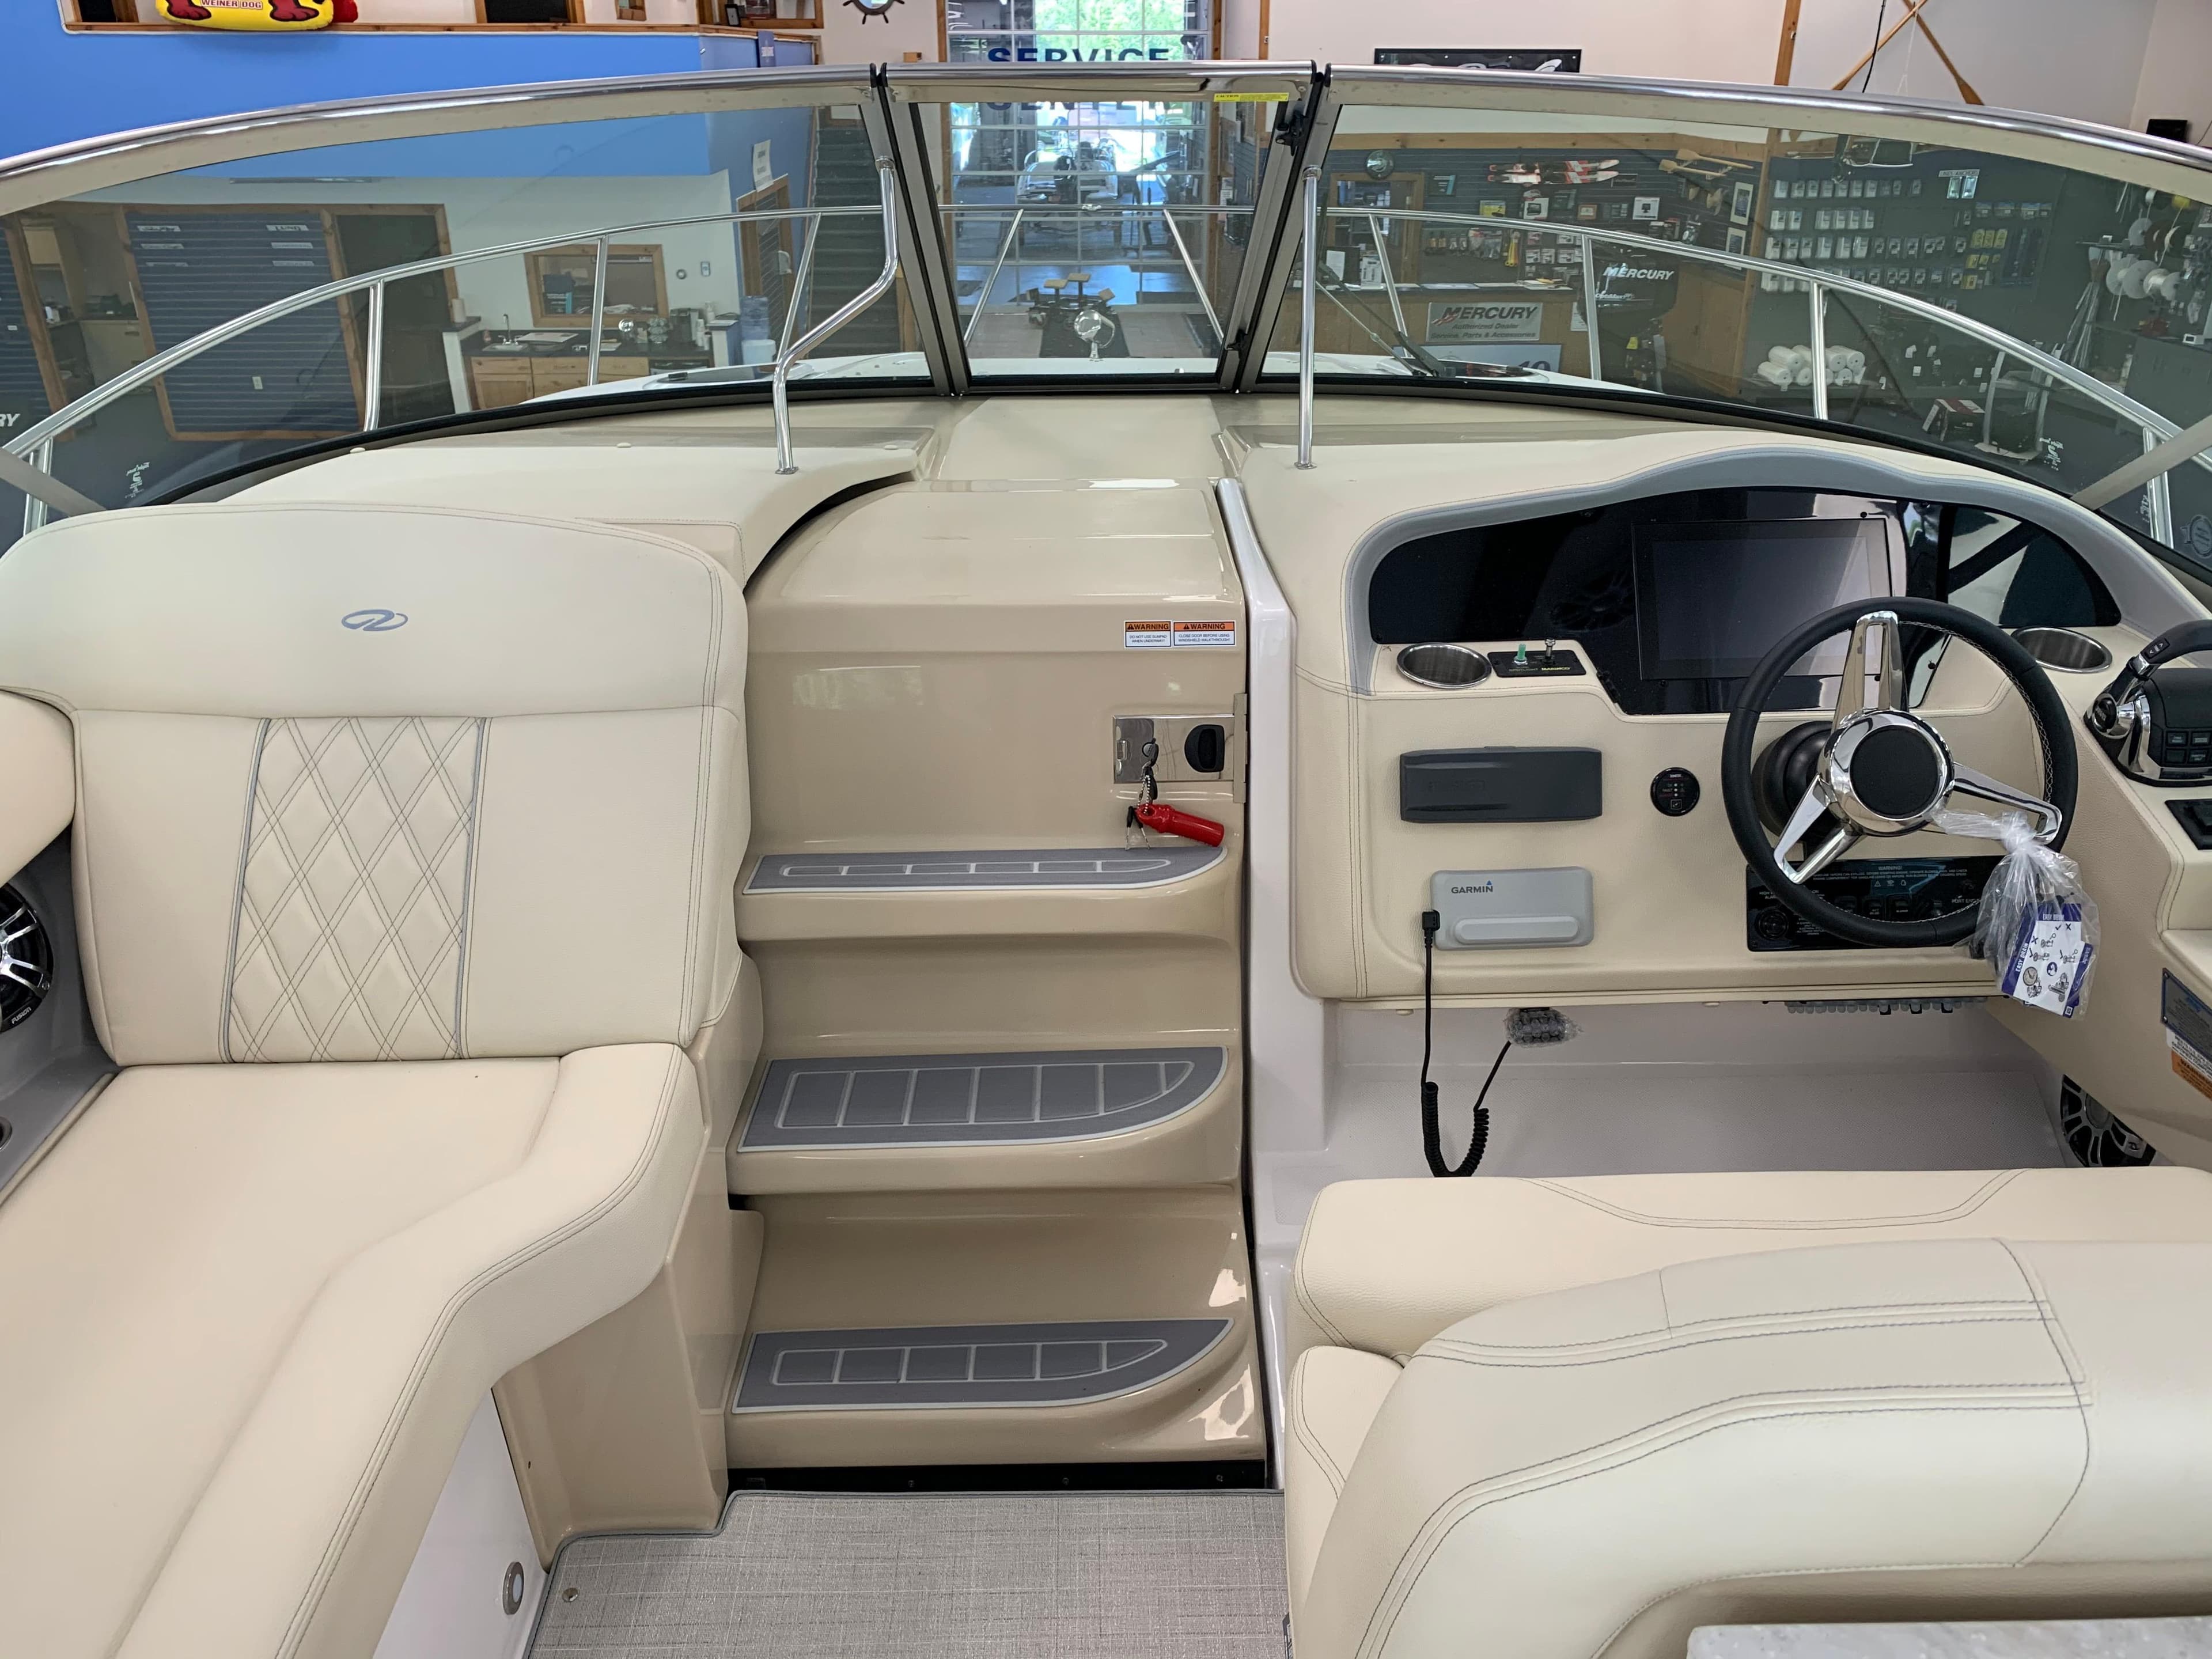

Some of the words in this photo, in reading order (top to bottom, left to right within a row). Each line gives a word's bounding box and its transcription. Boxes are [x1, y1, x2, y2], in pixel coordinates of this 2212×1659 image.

[1603, 267, 1675, 280] MERCURY
[1441, 306, 1537, 319] MERCURY
[1450, 885, 1494, 893] GARMIN
[2015, 959, 2024, 972] EASY
[2020, 942, 2029, 959] DRAIN
[11, 1006, 32, 1024] FUSION
